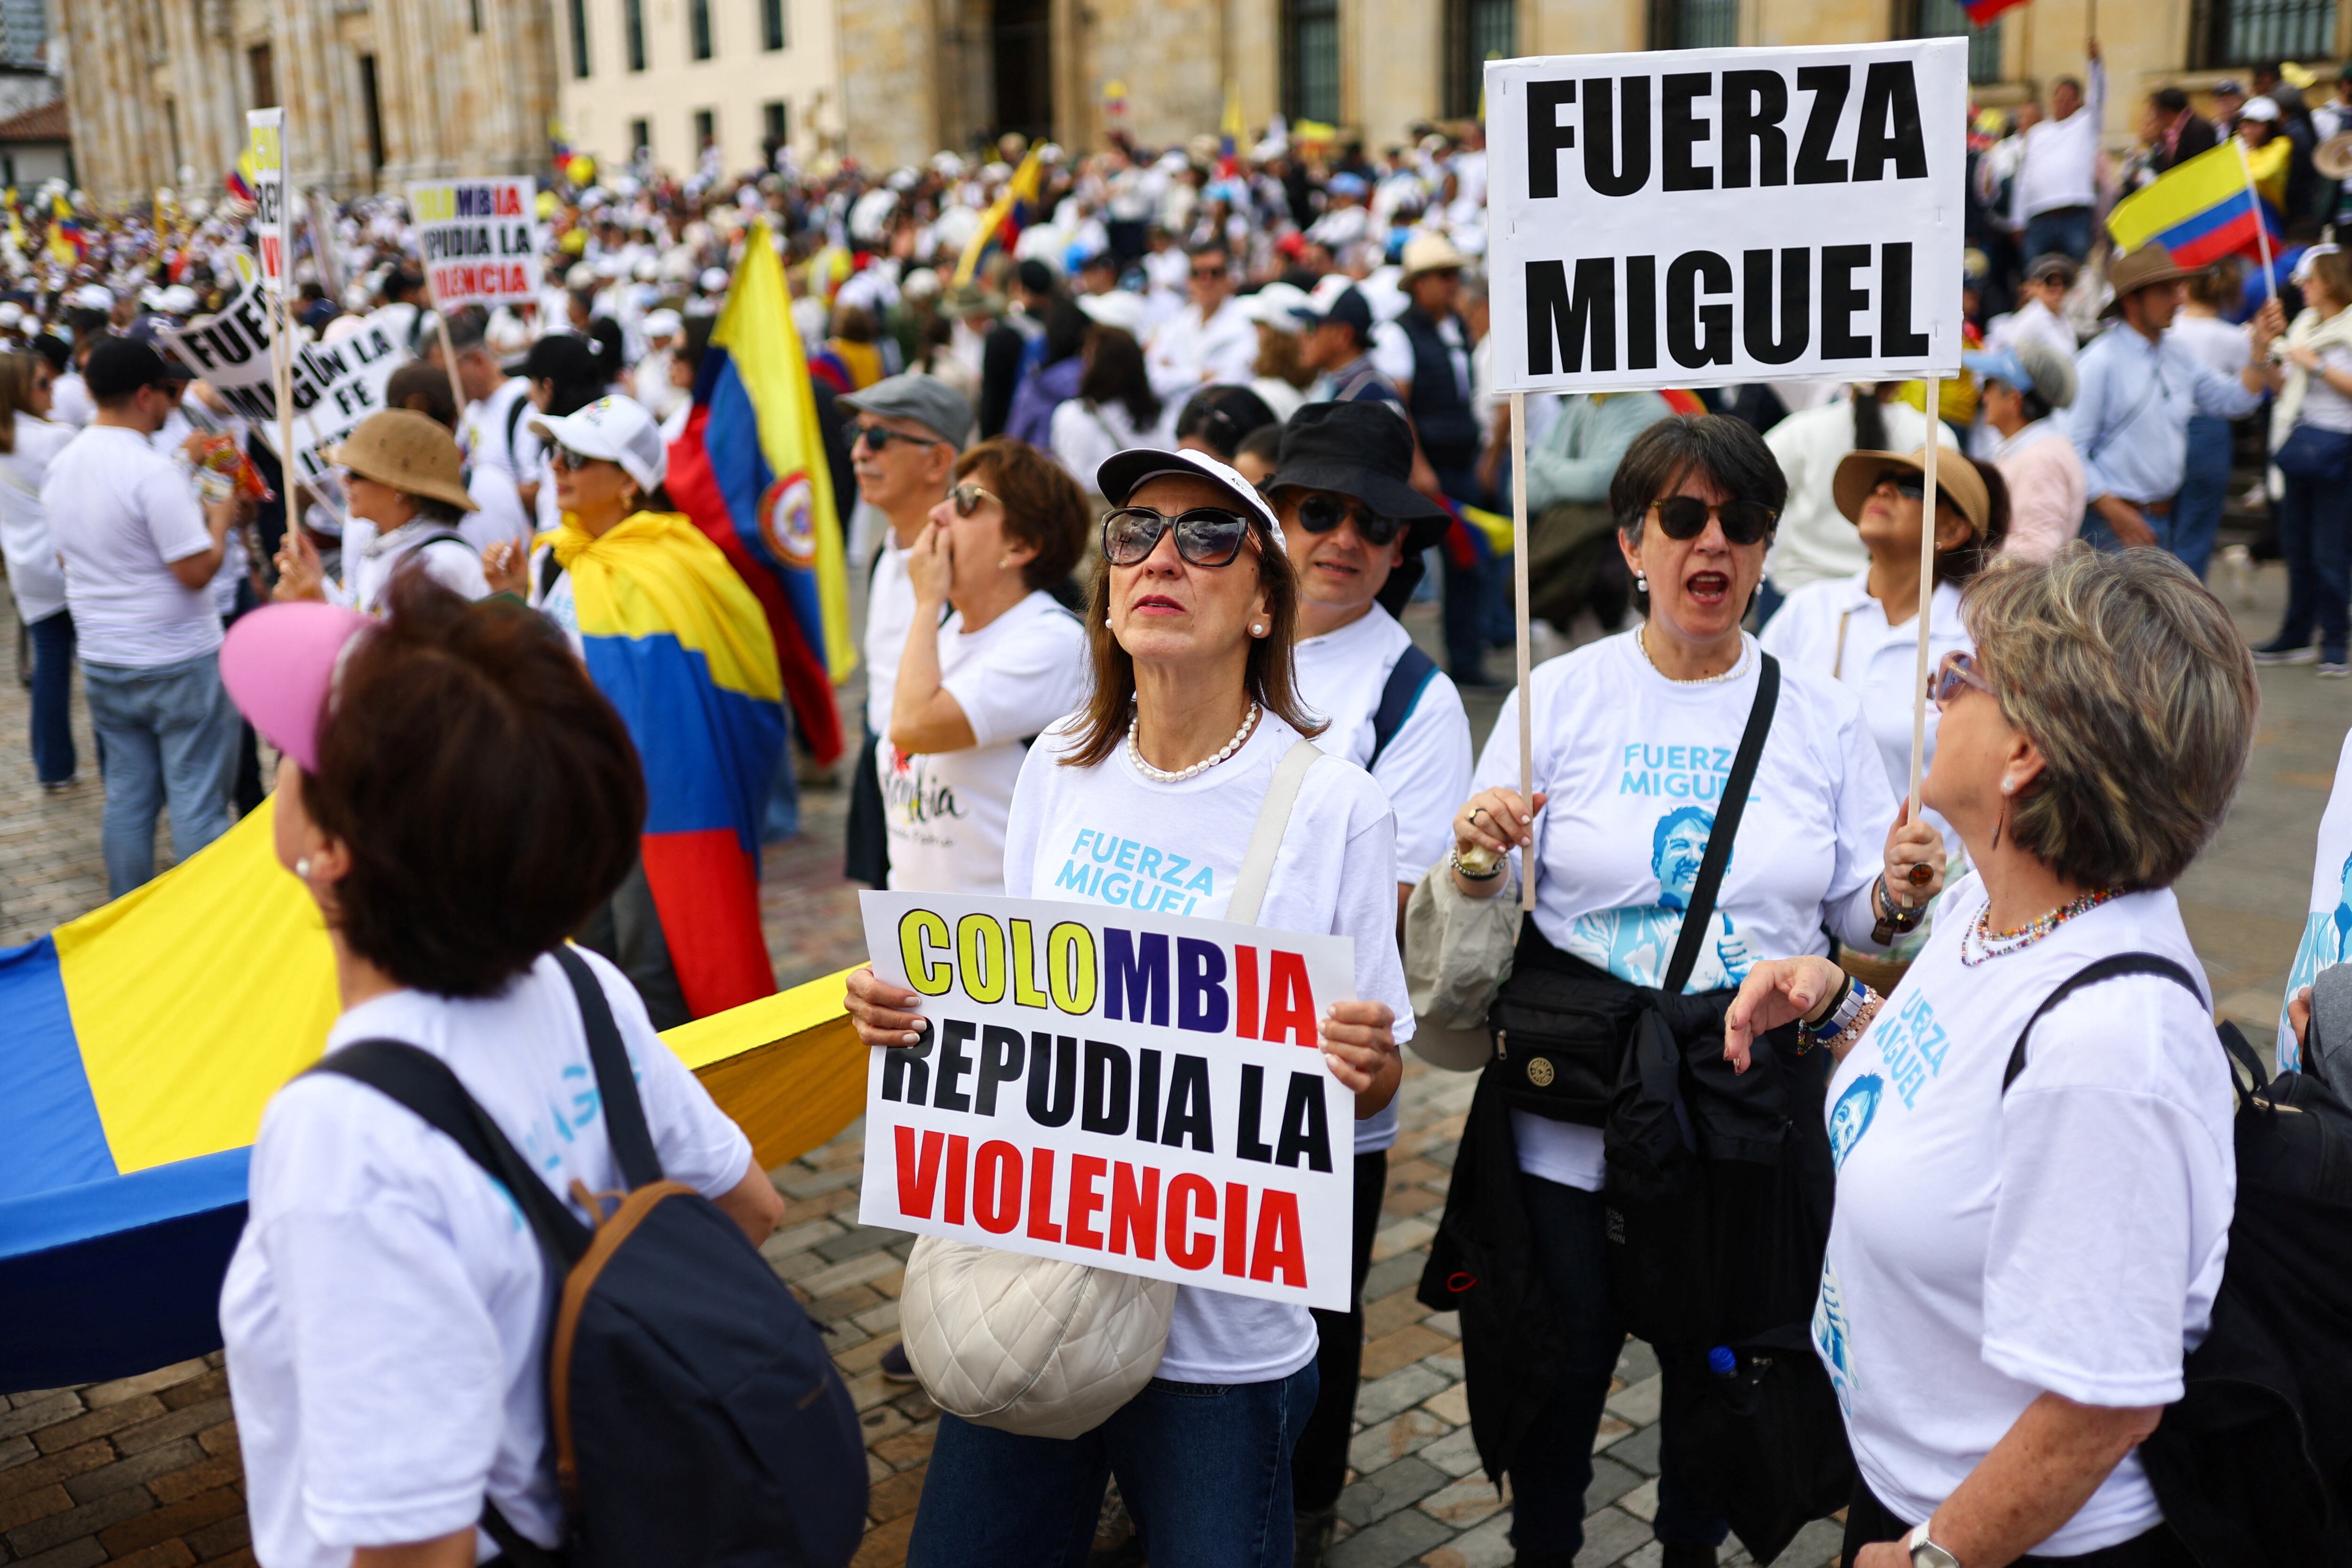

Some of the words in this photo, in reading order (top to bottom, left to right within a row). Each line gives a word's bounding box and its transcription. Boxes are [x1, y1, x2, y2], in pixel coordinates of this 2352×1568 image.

[1526, 60, 1928, 199] FUERZA
[500, 225, 532, 254] LA
[351, 329, 393, 364] LA
[1526, 242, 1929, 375] MIGUEL
[334, 377, 373, 415] FE
[1620, 771, 1761, 802] MIGU
[1625, 743, 1732, 772] FUERZ
[1071, 828, 1213, 897] FUERZA
[898, 908, 1319, 1048] COLOMBIA
[1900, 987, 1951, 1078] UERZA
[882, 1018, 1214, 1154] REPUDIA
[1236, 1063, 1333, 1173] LA
[894, 1124, 1308, 1289] VIOLENCIA
